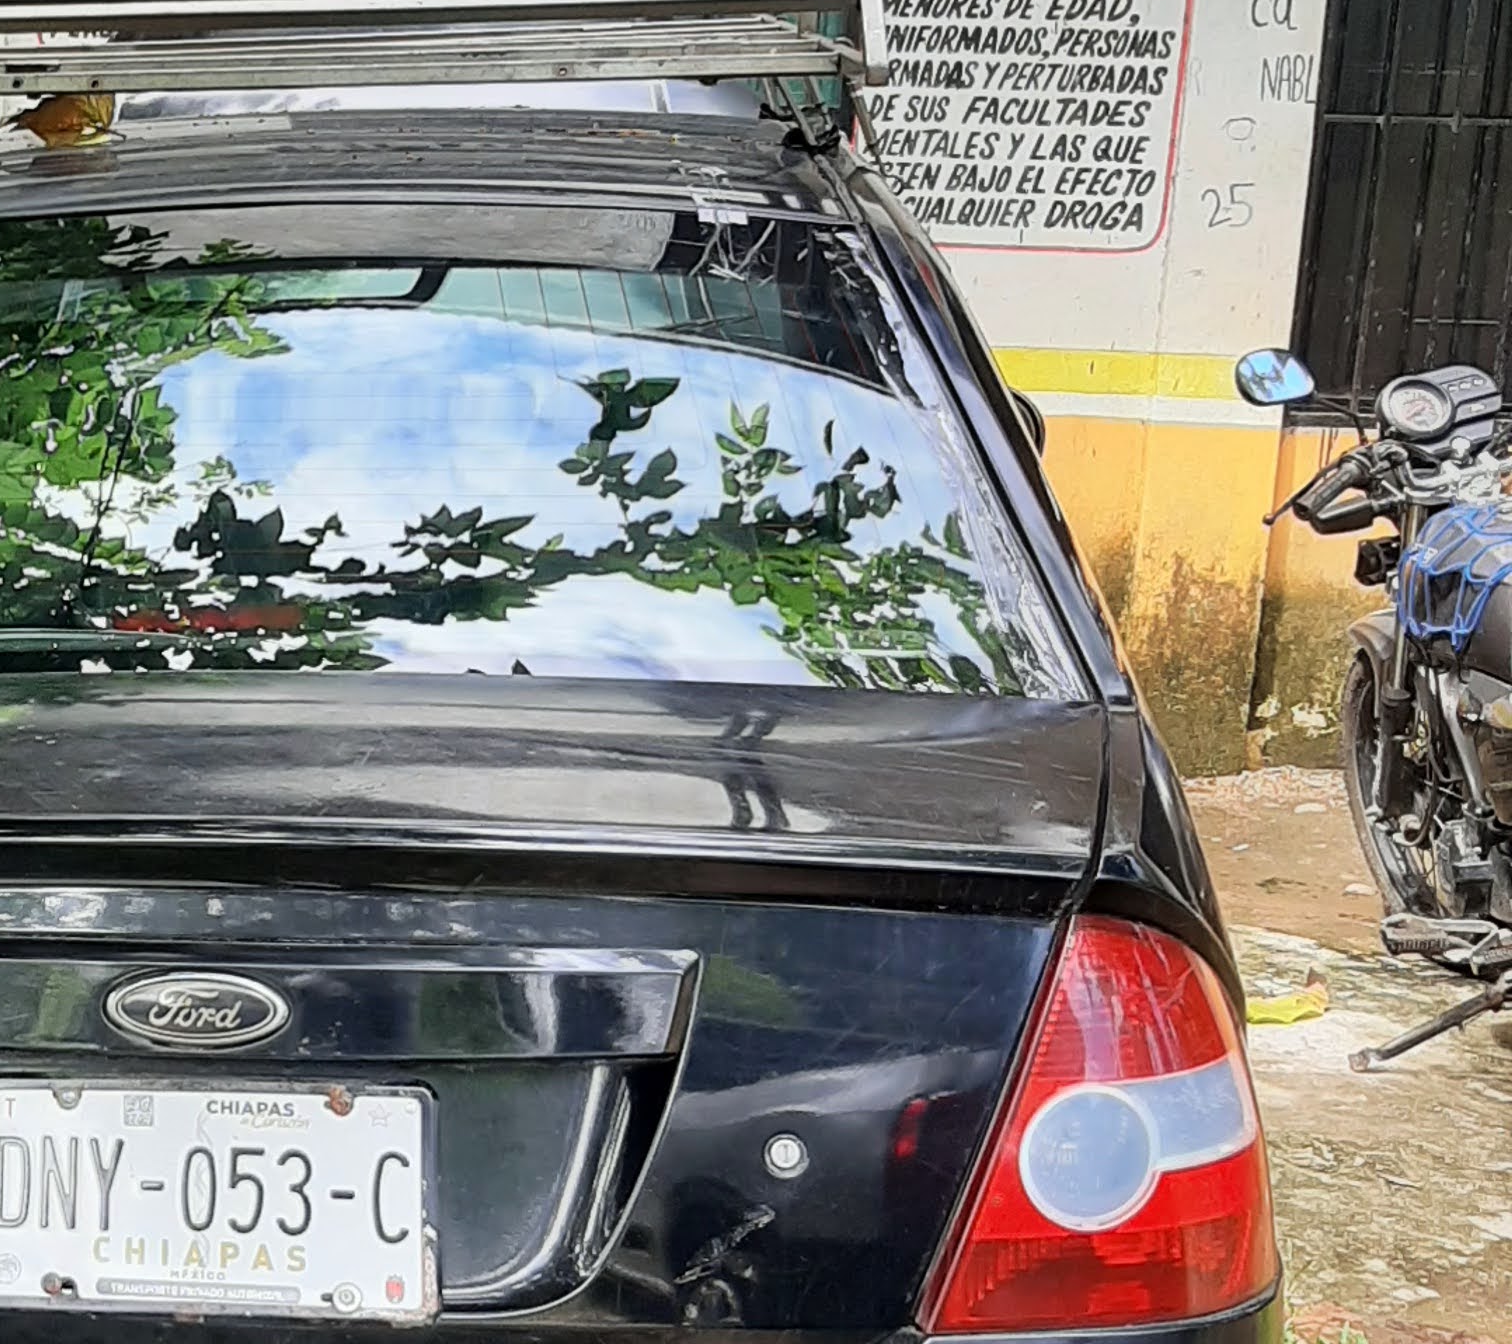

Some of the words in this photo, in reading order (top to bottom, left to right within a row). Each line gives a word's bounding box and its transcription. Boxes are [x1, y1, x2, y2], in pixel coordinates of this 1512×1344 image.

[886, 25, 1050, 61] NIFORMADOS,
[1052, 27, 1176, 59] PERSONAS
[888, 58, 979, 90] RMADAS
[982, 62, 1000, 89] Y
[997, 62, 1168, 95] PERTURBADAS
[870, 94, 900, 122] DE
[904, 95, 950, 123] SUS
[961, 96, 1152, 128] FACULTADES
[864, 128, 1000, 160] MENTALES
[1006, 132, 1025, 160] Y
[1029, 133, 1086, 163] LAS
[1092, 135, 1150, 164] QUE
[944, 163, 1012, 193] BAJO
[1016, 165, 1046, 194] EL
[1054, 166, 1156, 197] EFECTO
[1043, 200, 1143, 232] DROGA
[148, 987, 242, 1028] Ford
[206, 1100, 295, 1117] CHIAPAS
[93, 1236, 307, 1272] CHIAPAS
